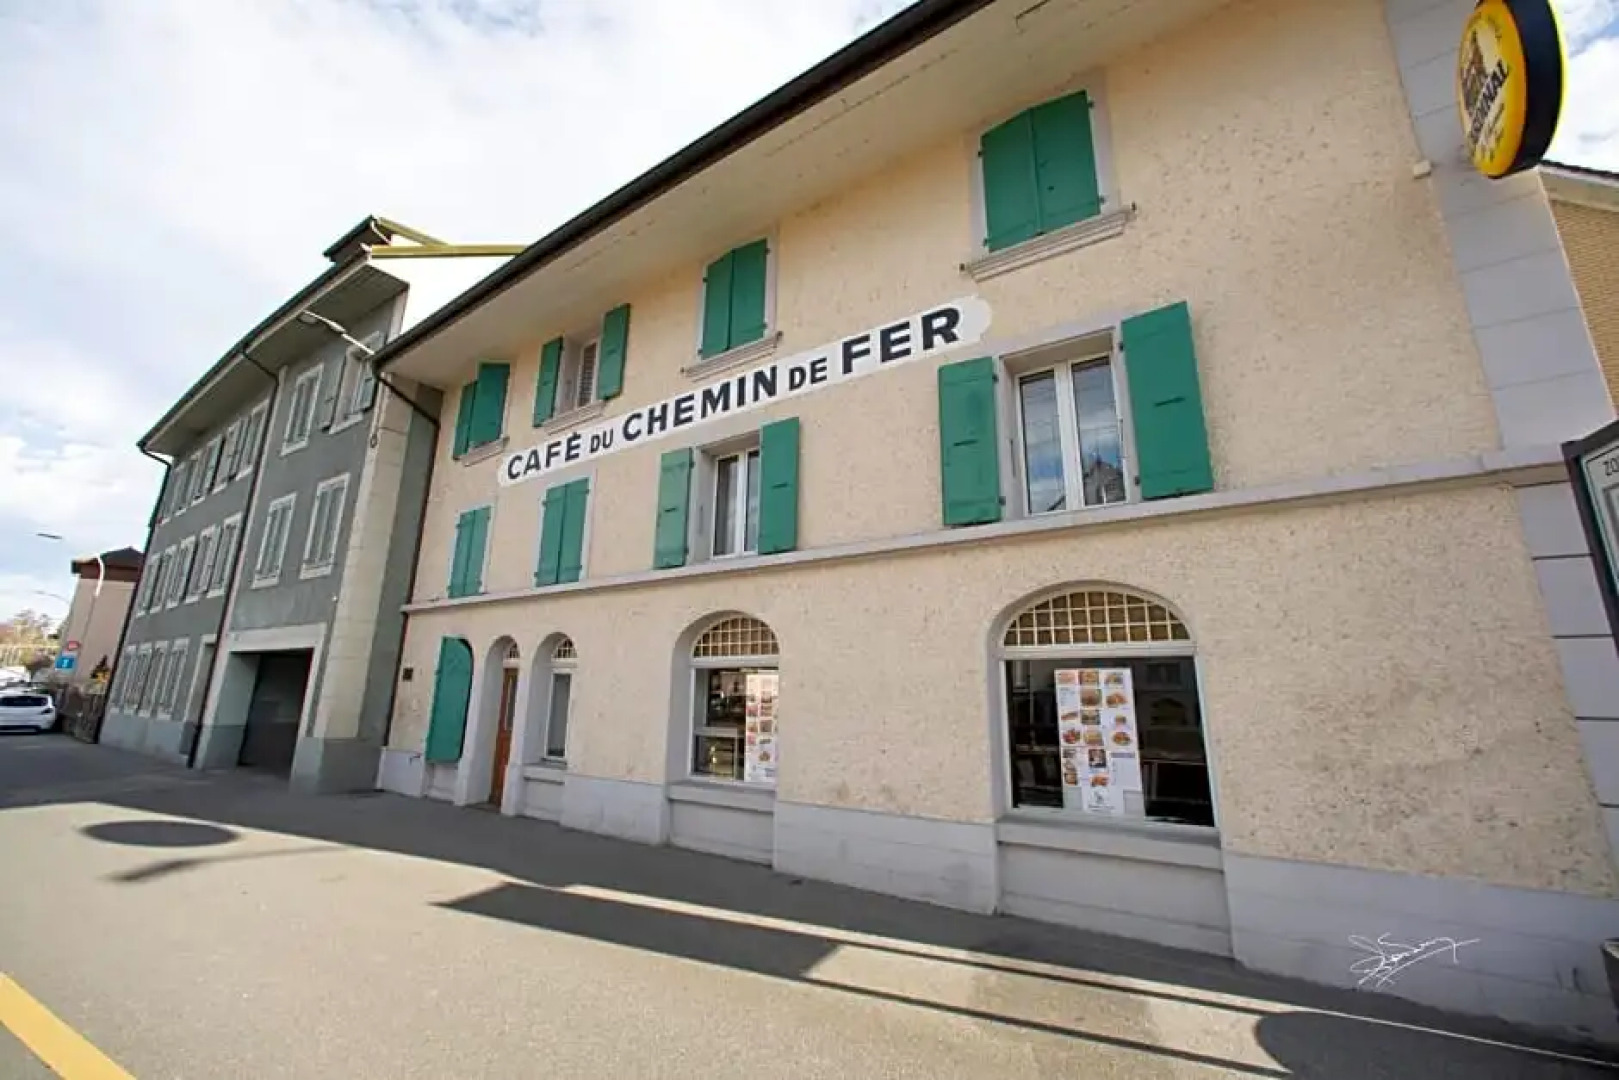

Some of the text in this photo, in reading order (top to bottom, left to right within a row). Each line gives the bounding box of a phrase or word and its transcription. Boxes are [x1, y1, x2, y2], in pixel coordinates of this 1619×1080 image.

[507, 307, 960, 480] CAFÉ DU CHEMIN DE FER
